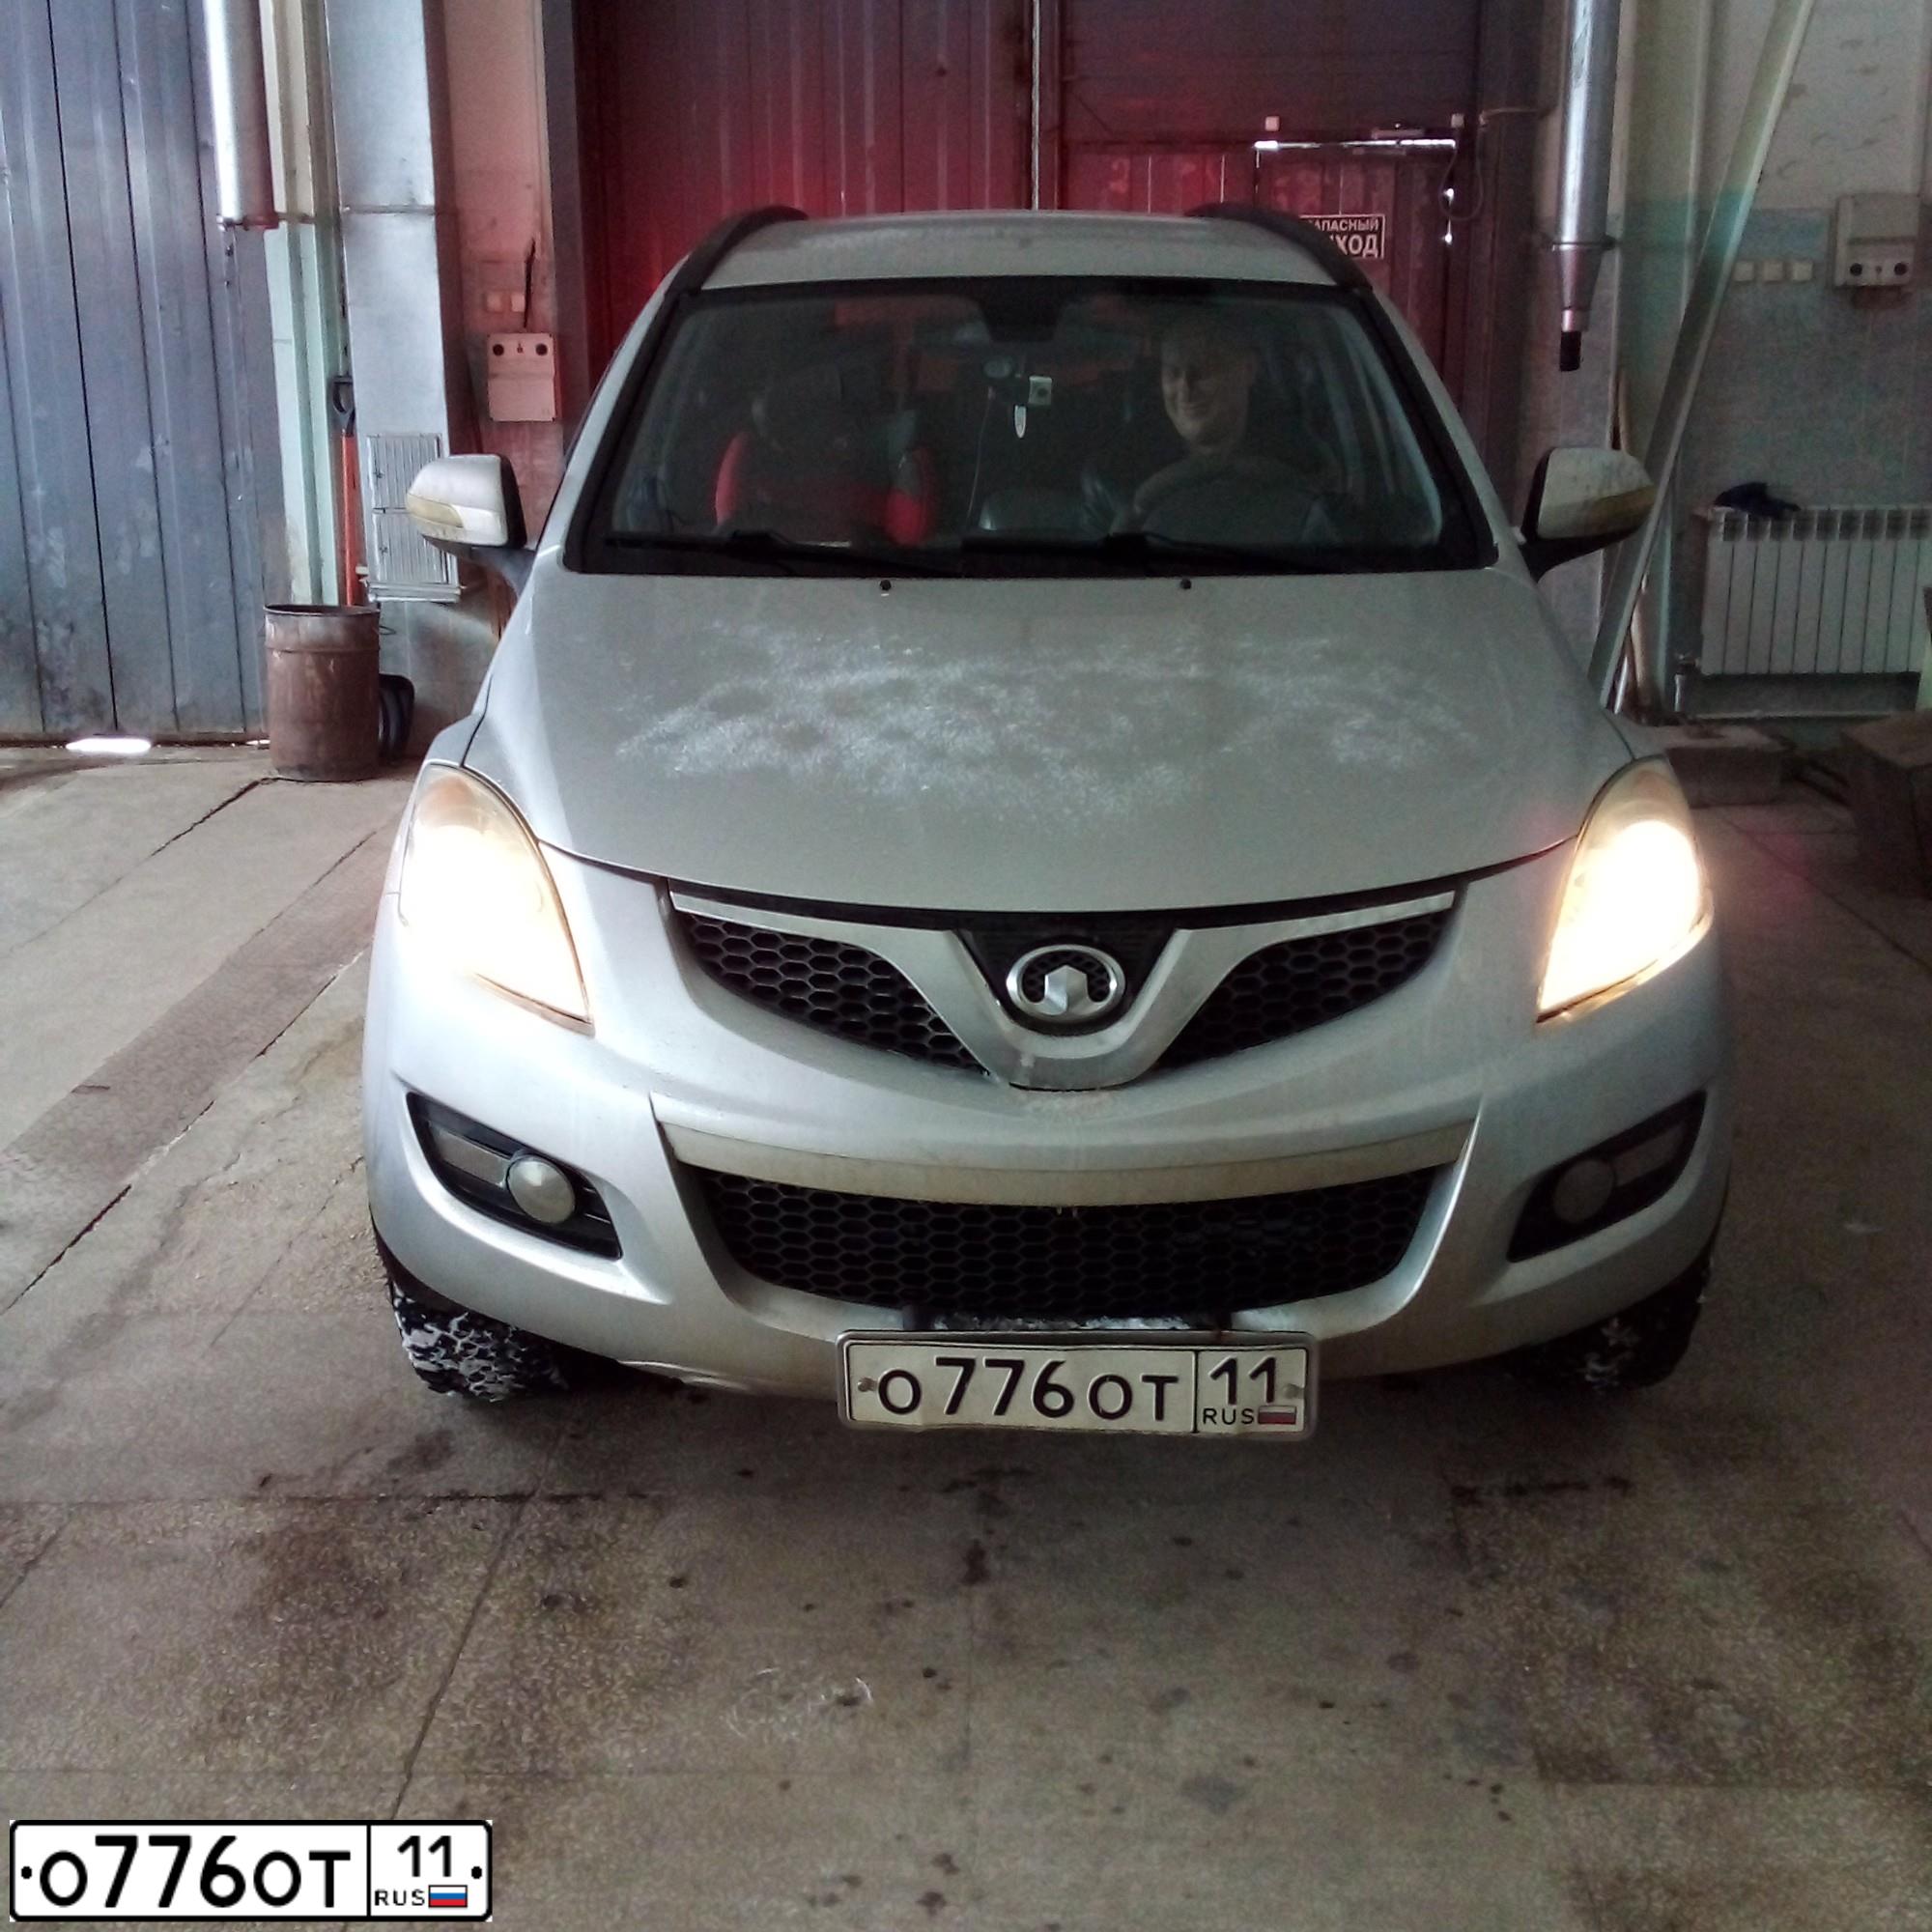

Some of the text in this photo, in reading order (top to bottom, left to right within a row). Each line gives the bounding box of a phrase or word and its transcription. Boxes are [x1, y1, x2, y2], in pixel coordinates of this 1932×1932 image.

[1308, 218, 1379, 232] АПАСНЫЙ
[1330, 234, 1379, 259] ХОД
[1208, 1355, 1277, 1406] 11
[1202, 1407, 1255, 1426] RUS
